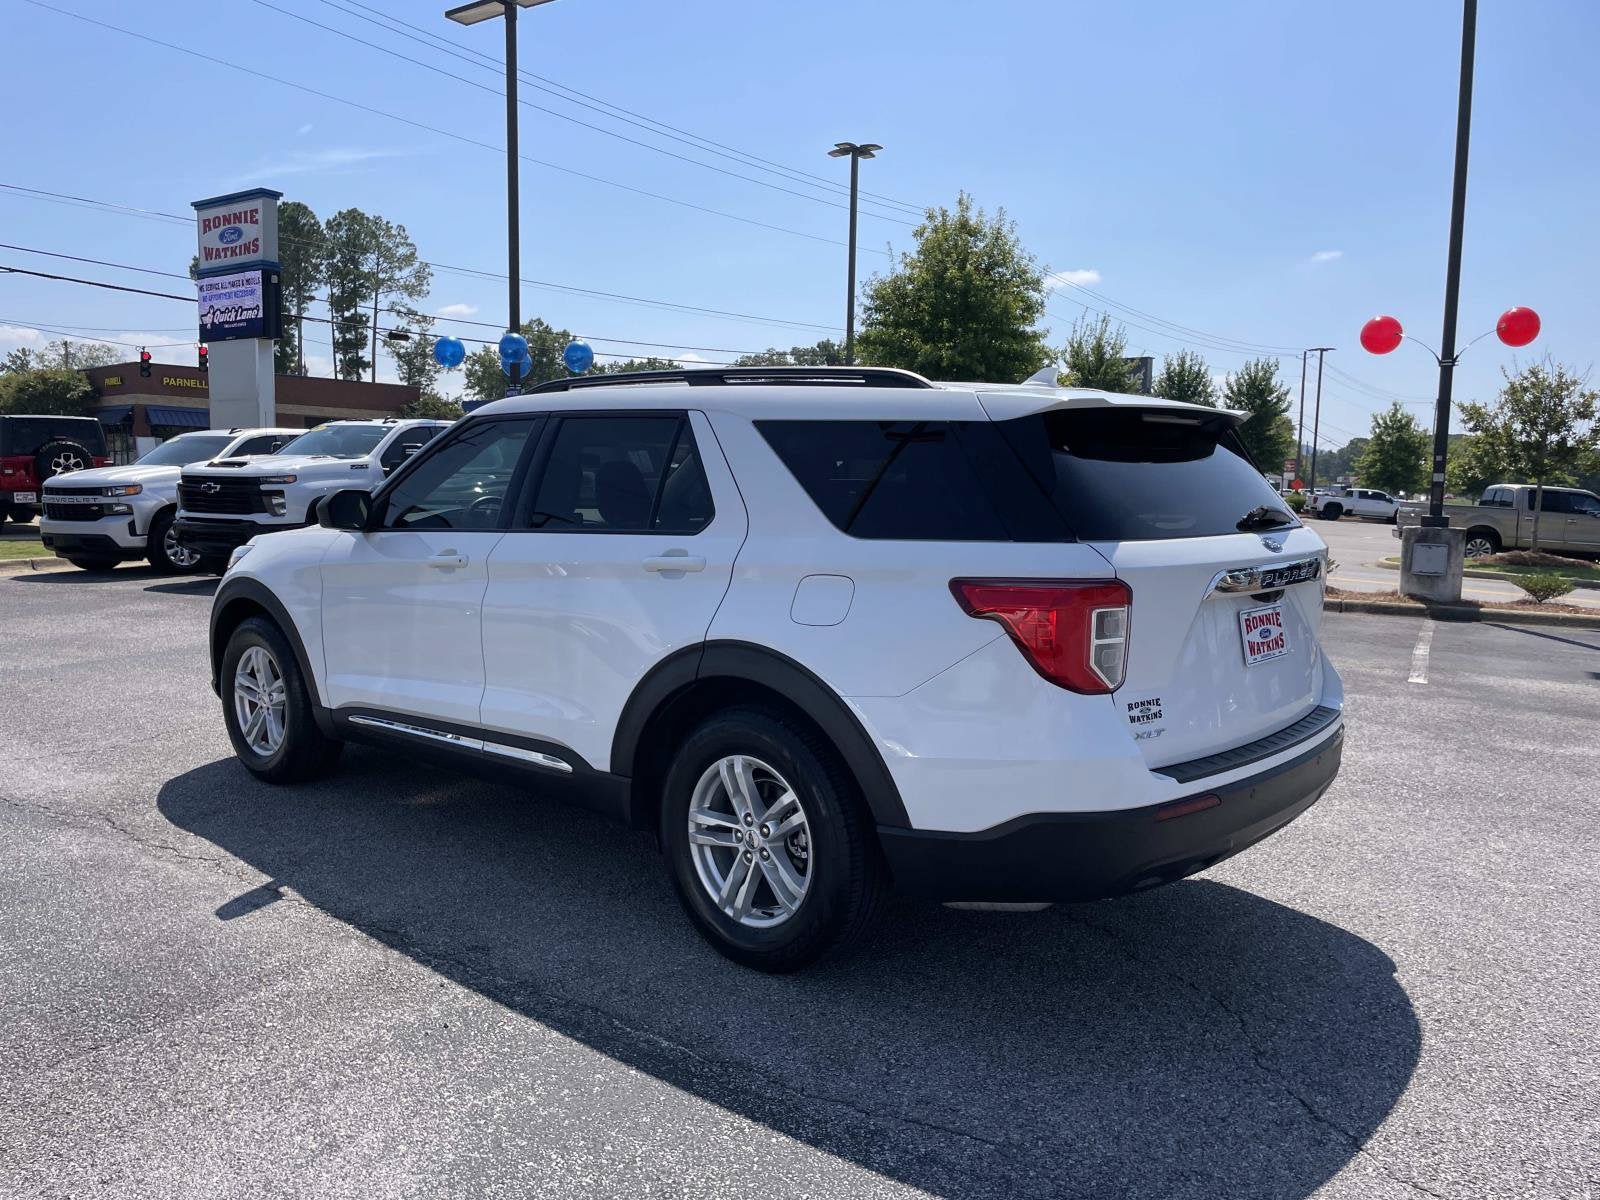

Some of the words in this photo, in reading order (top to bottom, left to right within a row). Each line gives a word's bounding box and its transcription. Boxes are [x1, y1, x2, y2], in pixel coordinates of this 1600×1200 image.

[202, 208, 259, 235] RONNIE
[203, 237, 260, 261] WATKINS
[213, 307, 236, 324] Quick
[236, 307, 258, 321] Lane
[163, 376, 209, 389] PARNELL
[1244, 611, 1282, 635] RONNIE
[1248, 632, 1284, 656] WATKINS
[1127, 698, 1161, 712] RONNIE
[1129, 709, 1163, 723] WATKINS
